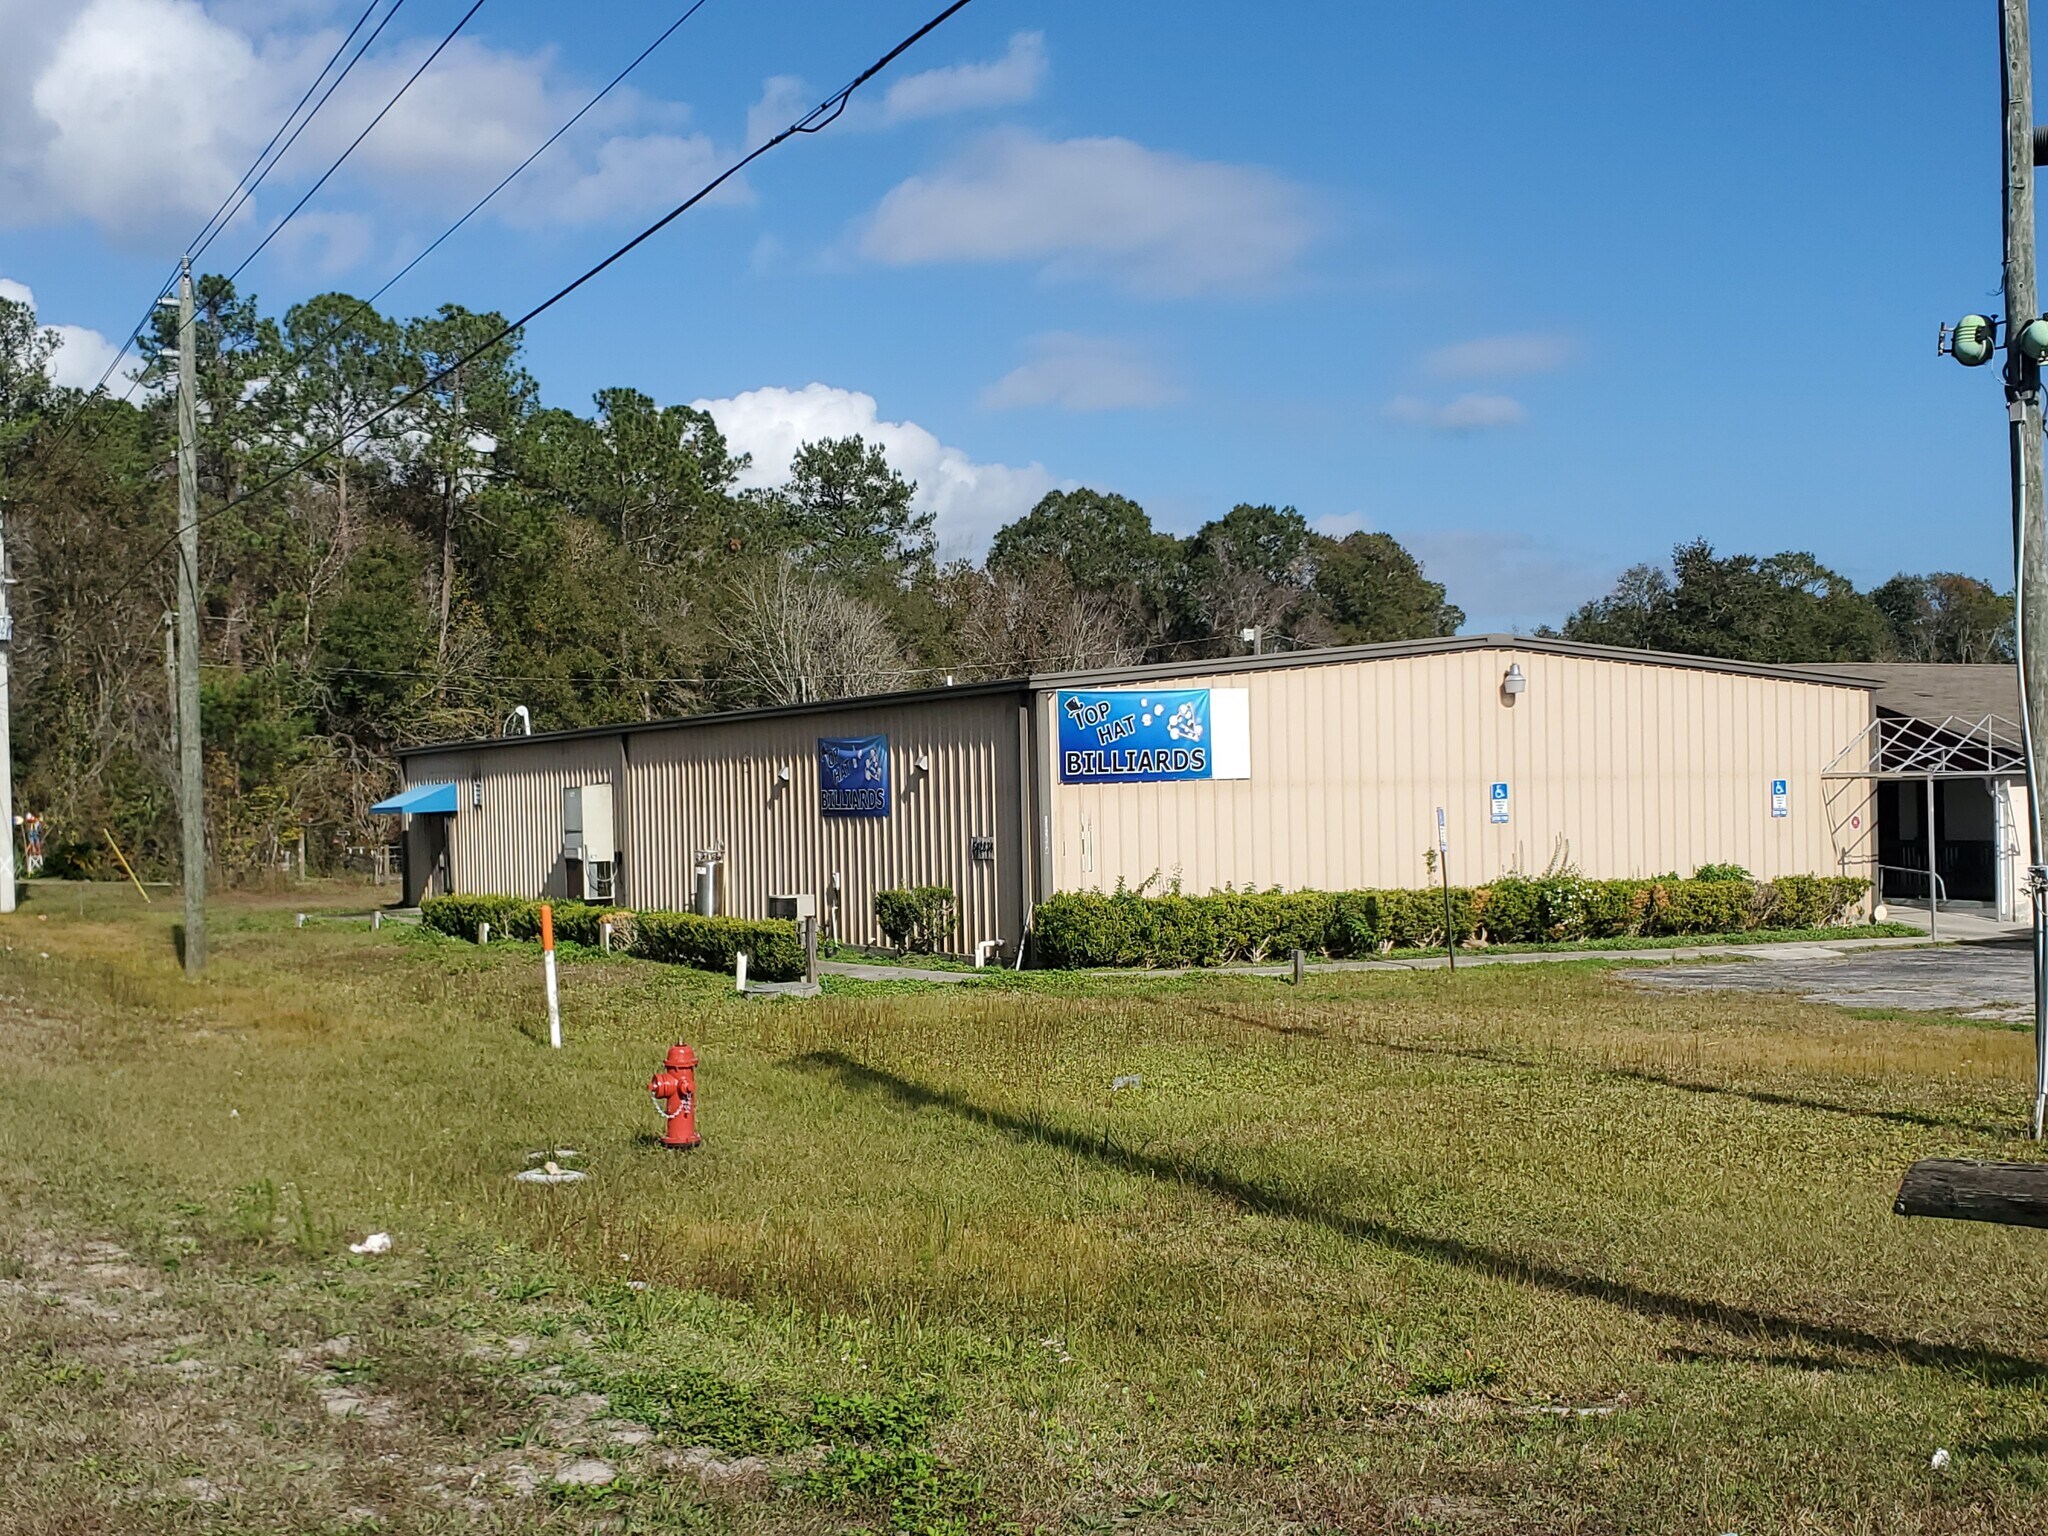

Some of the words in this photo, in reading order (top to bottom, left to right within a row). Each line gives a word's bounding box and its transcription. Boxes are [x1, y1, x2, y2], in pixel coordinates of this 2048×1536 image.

[1067, 700, 1110, 730] TOP
[1097, 714, 1136, 746] HAT
[1066, 749, 1205, 775] BILLIARDS
[821, 788, 885, 810] BILLIARDS
